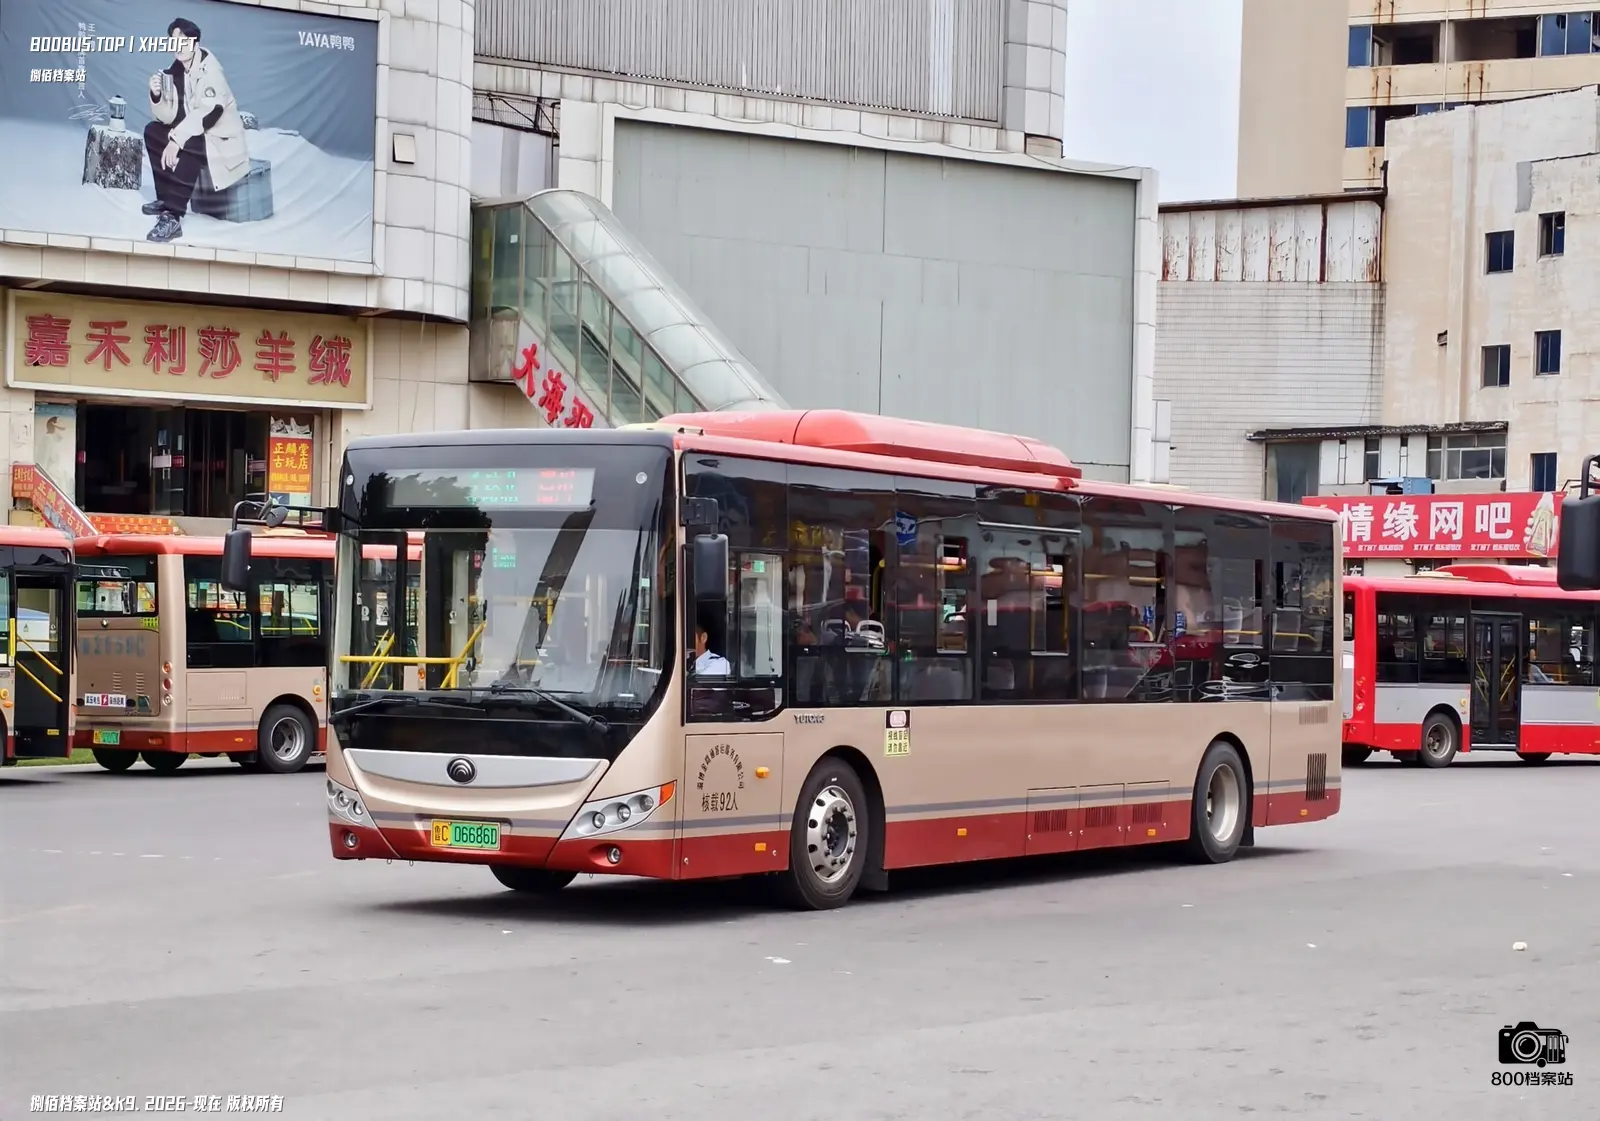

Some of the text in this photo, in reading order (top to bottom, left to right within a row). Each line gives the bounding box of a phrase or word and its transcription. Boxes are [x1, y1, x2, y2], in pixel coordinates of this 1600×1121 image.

[298, 30, 355, 51] YAYA鸭鸭
[25, 313, 354, 387] 嘉禾利莎羊绒
[701, 791, 739, 812] 核载92人
[434, 825, 449, 842] 鲁C
